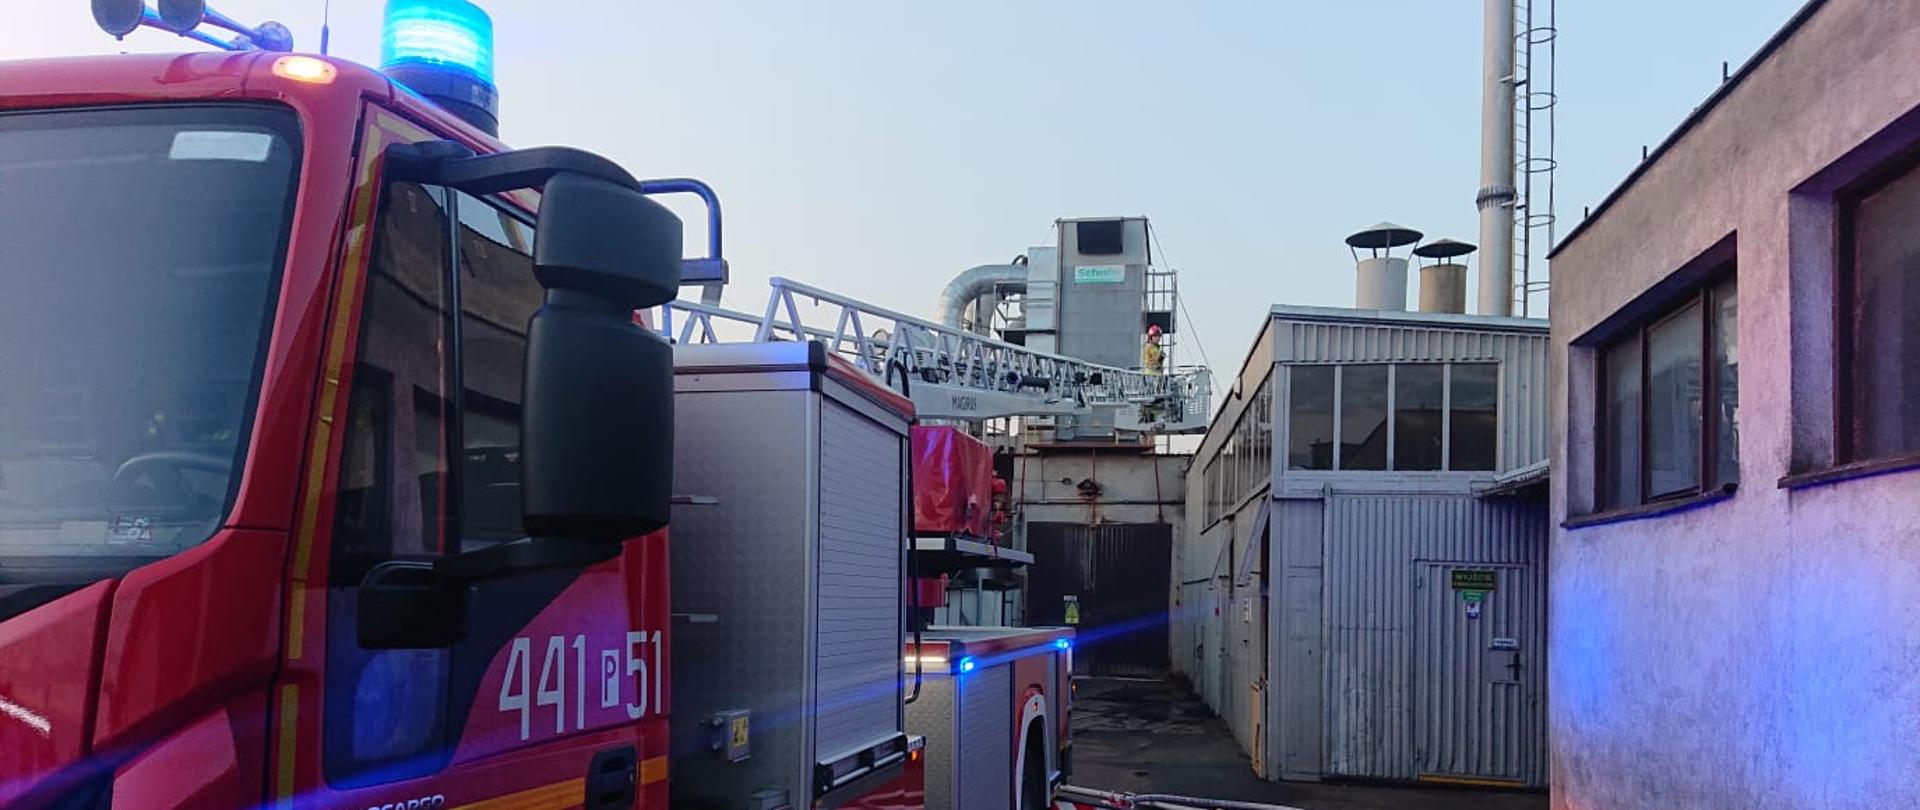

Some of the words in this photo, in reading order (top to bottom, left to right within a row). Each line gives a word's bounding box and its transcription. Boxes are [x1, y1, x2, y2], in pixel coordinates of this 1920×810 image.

[498, 634, 586, 741] 441
[603, 654, 617, 706] P
[626, 630, 662, 719] 51
